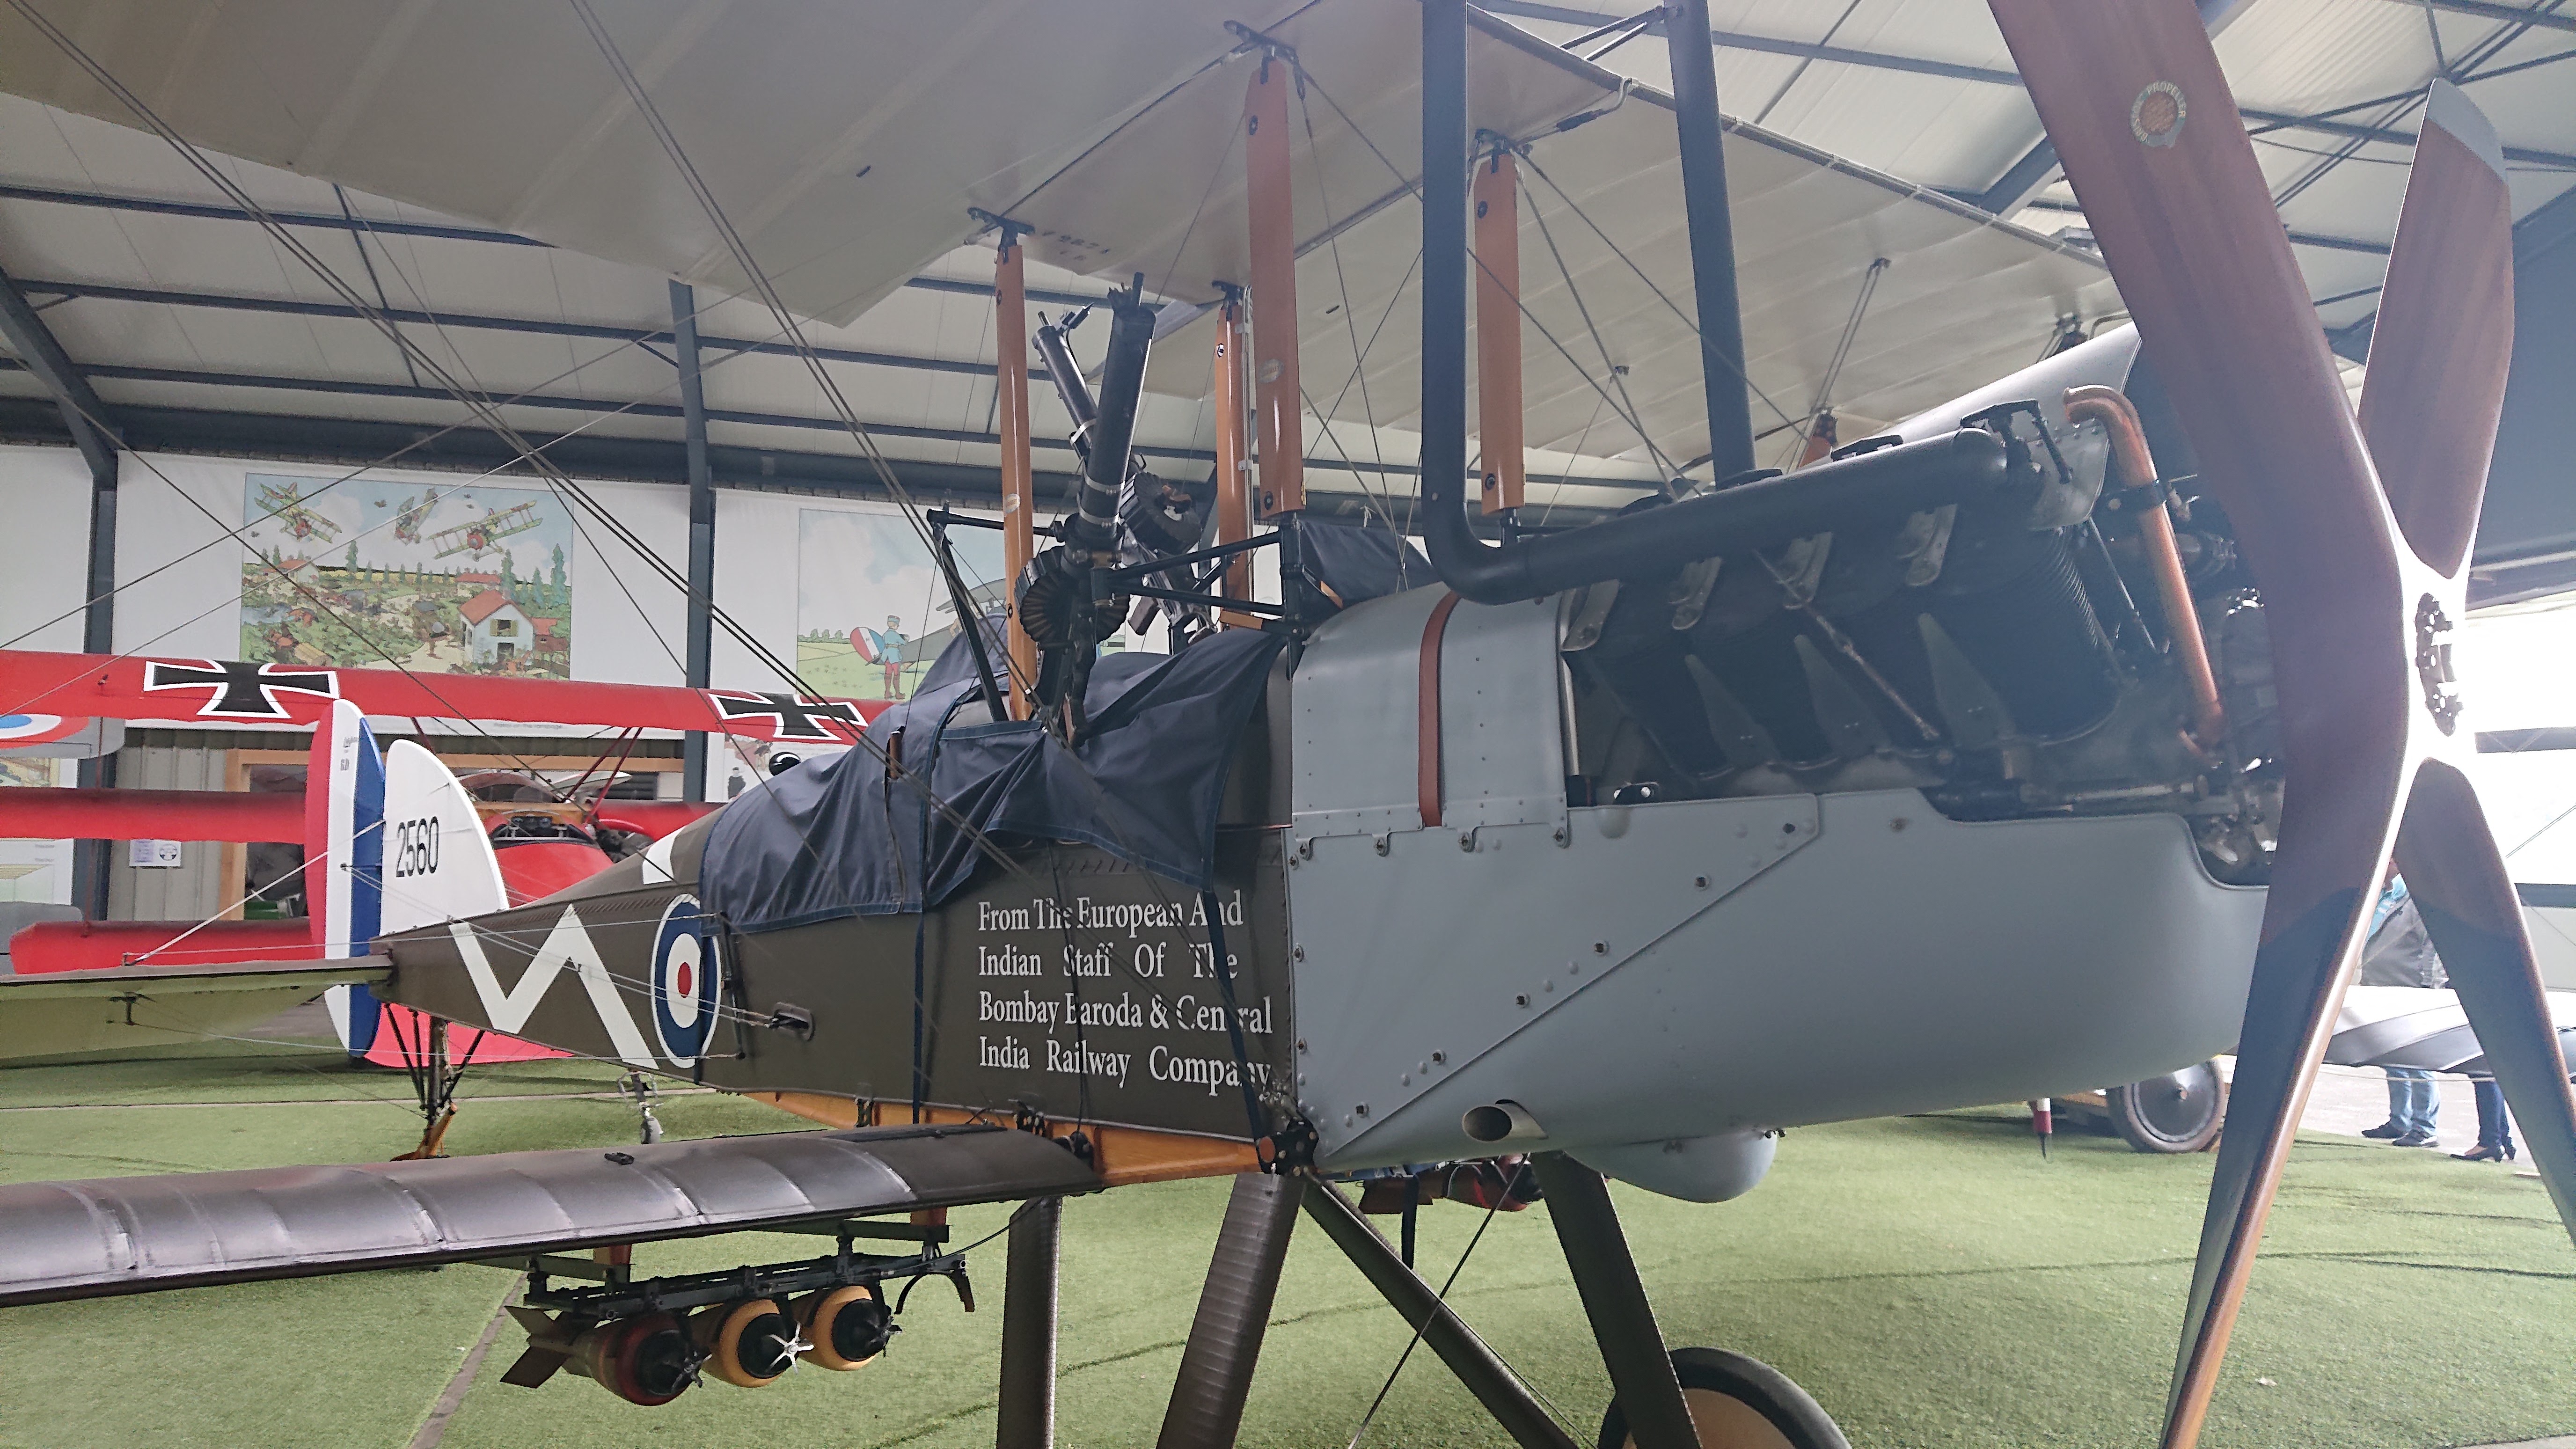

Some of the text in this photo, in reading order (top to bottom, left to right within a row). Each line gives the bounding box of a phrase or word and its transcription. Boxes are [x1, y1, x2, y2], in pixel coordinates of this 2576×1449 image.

[396, 816, 439, 877] 2560
[978, 901, 1030, 931] From
[1033, 897, 1073, 929] The
[1076, 897, 1183, 938] European
[979, 944, 1042, 976] Indian
[1063, 942, 1114, 977] Staff
[1134, 941, 1167, 977] Of
[979, 989, 1273, 1034] Bombay Baroda & Cenral
[980, 1035, 1271, 1097] India Railway Company
